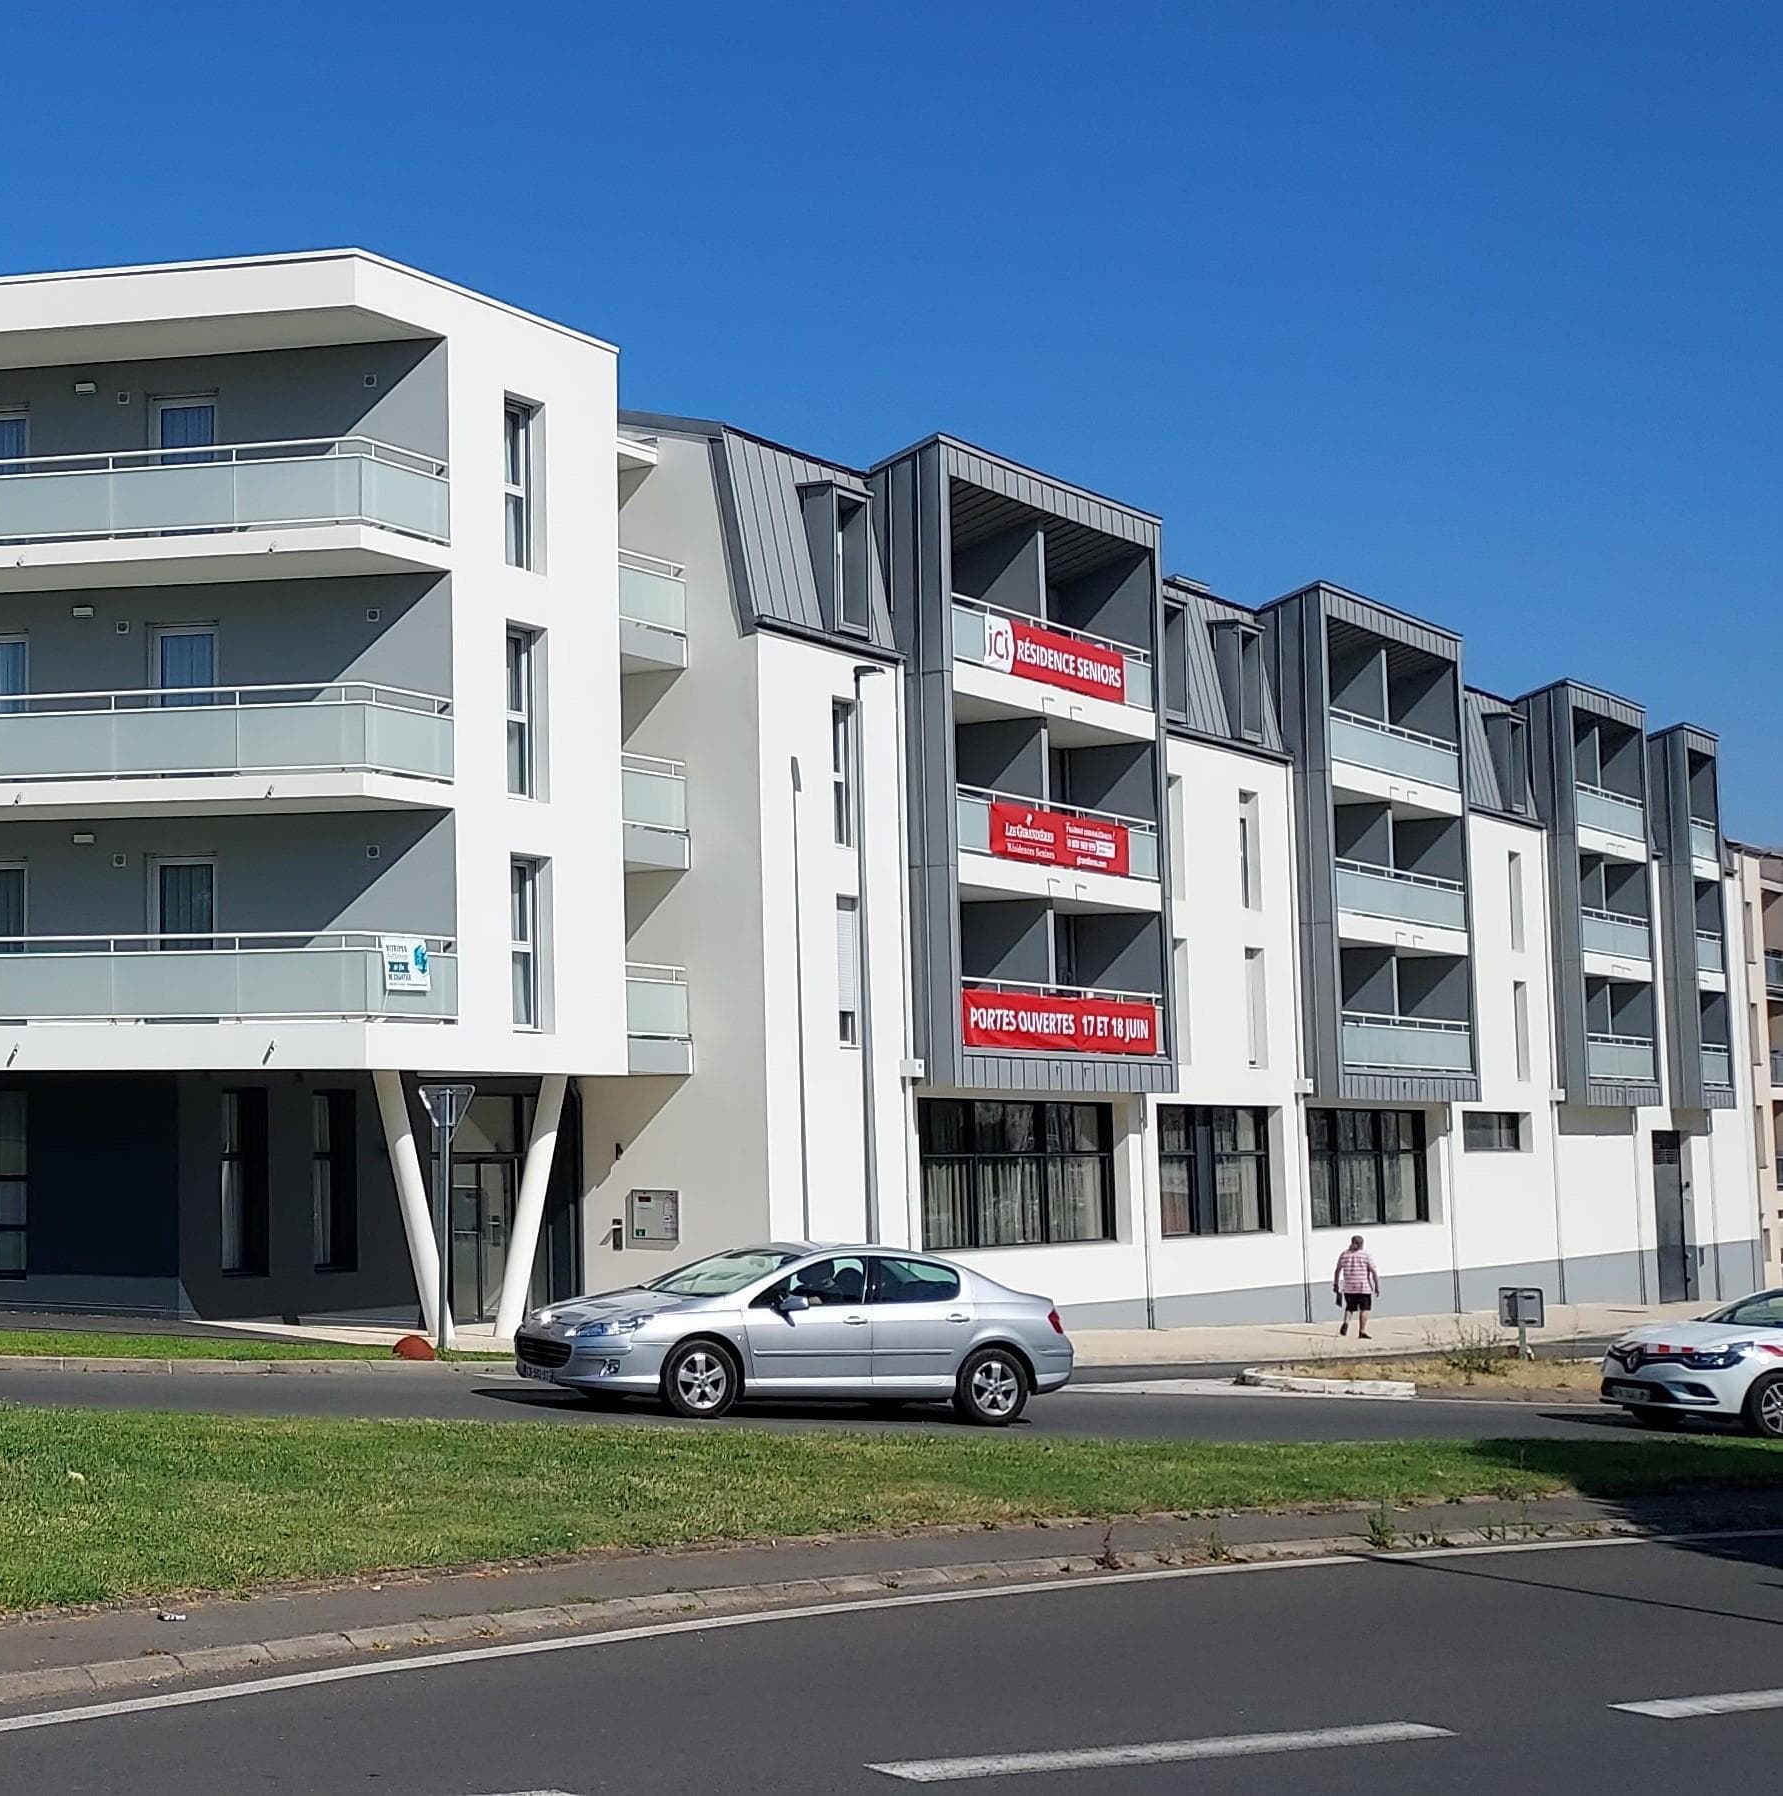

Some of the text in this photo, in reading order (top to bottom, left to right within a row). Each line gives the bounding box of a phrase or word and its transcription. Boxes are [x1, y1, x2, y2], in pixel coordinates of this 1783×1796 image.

[1016, 637, 1122, 688] RÉSIDENCE SENIORS
[969, 1007, 1149, 1043] PORTES OUVERTES 17 ET 18 JUIN
